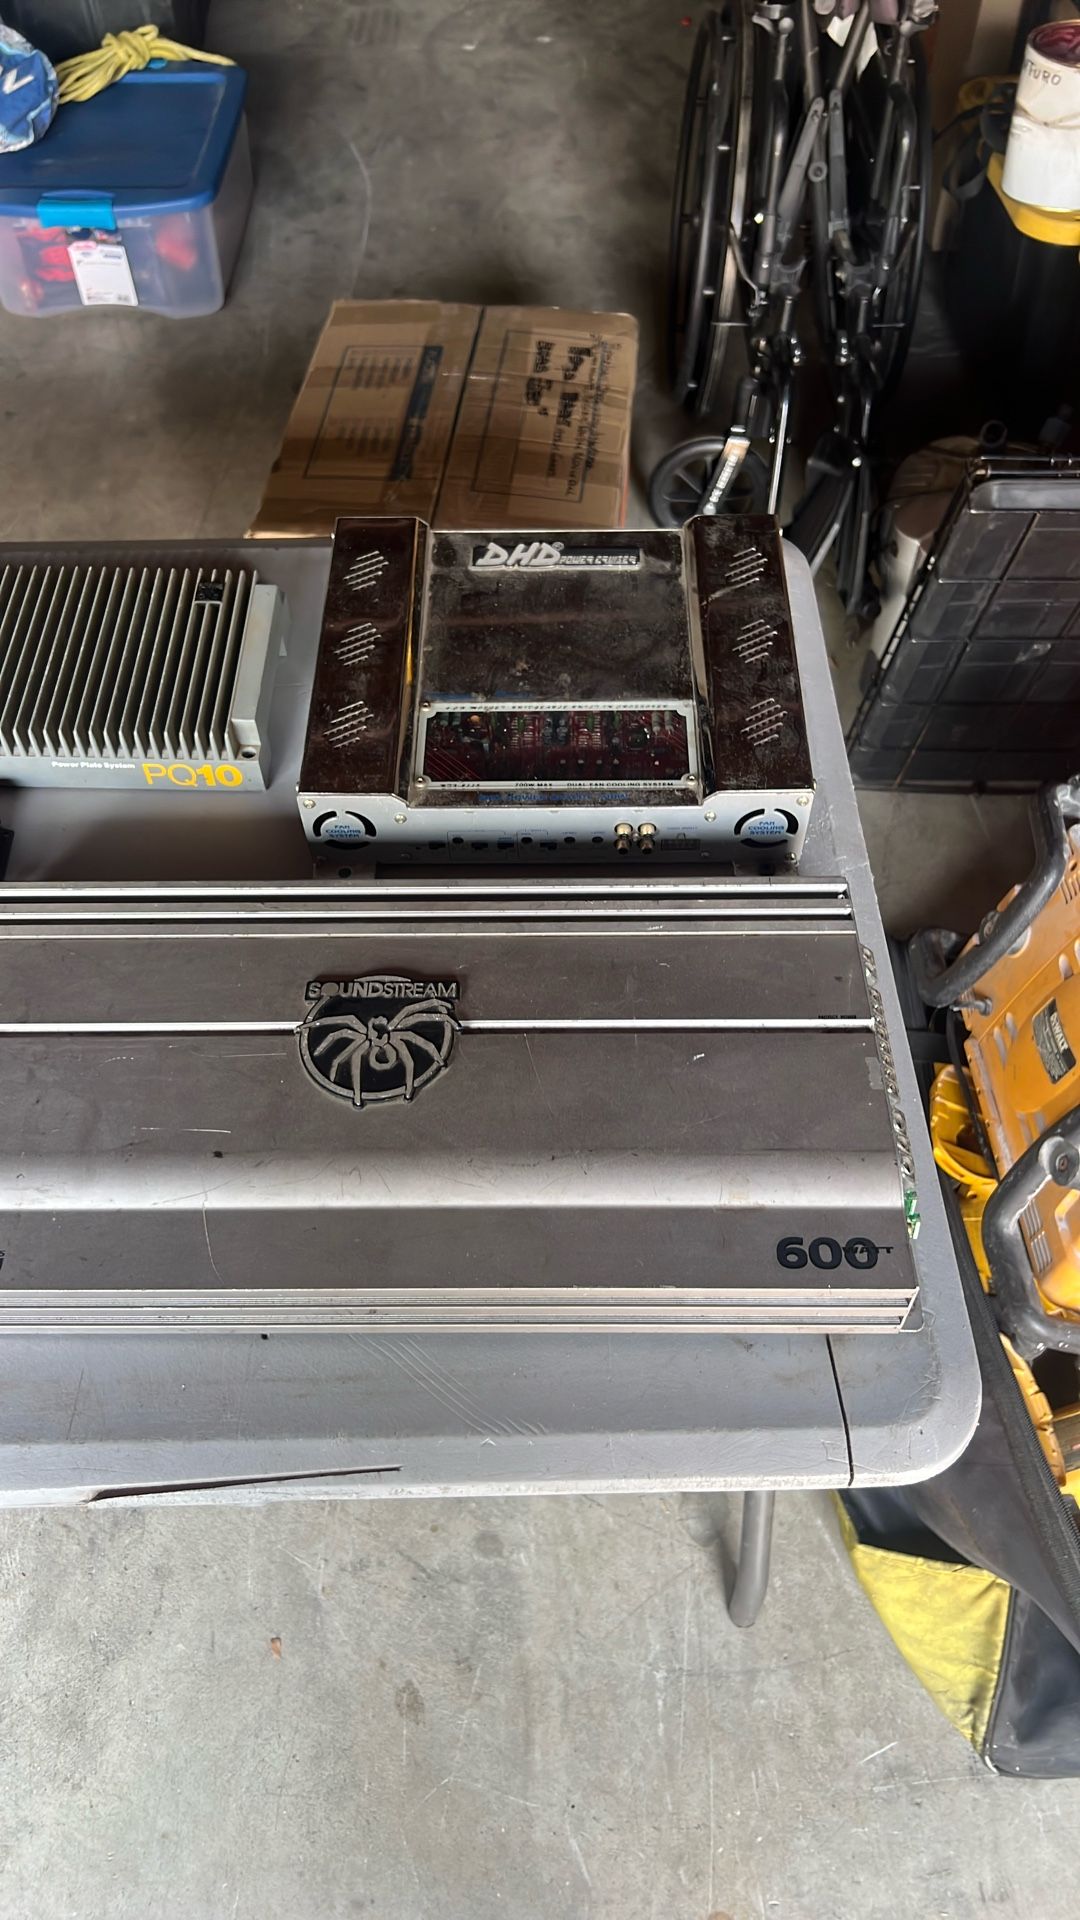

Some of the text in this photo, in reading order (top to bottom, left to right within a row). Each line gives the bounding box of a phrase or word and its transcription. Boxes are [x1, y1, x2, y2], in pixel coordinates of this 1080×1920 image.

[475, 542, 638, 566] DHD POWER CRUISER
[51, 761, 79, 769] Power
[103, 762, 136, 771] System
[142, 763, 243, 788] PQ10
[308, 981, 458, 998] SOUNDSTREAM
[776, 1236, 879, 1270] 600
